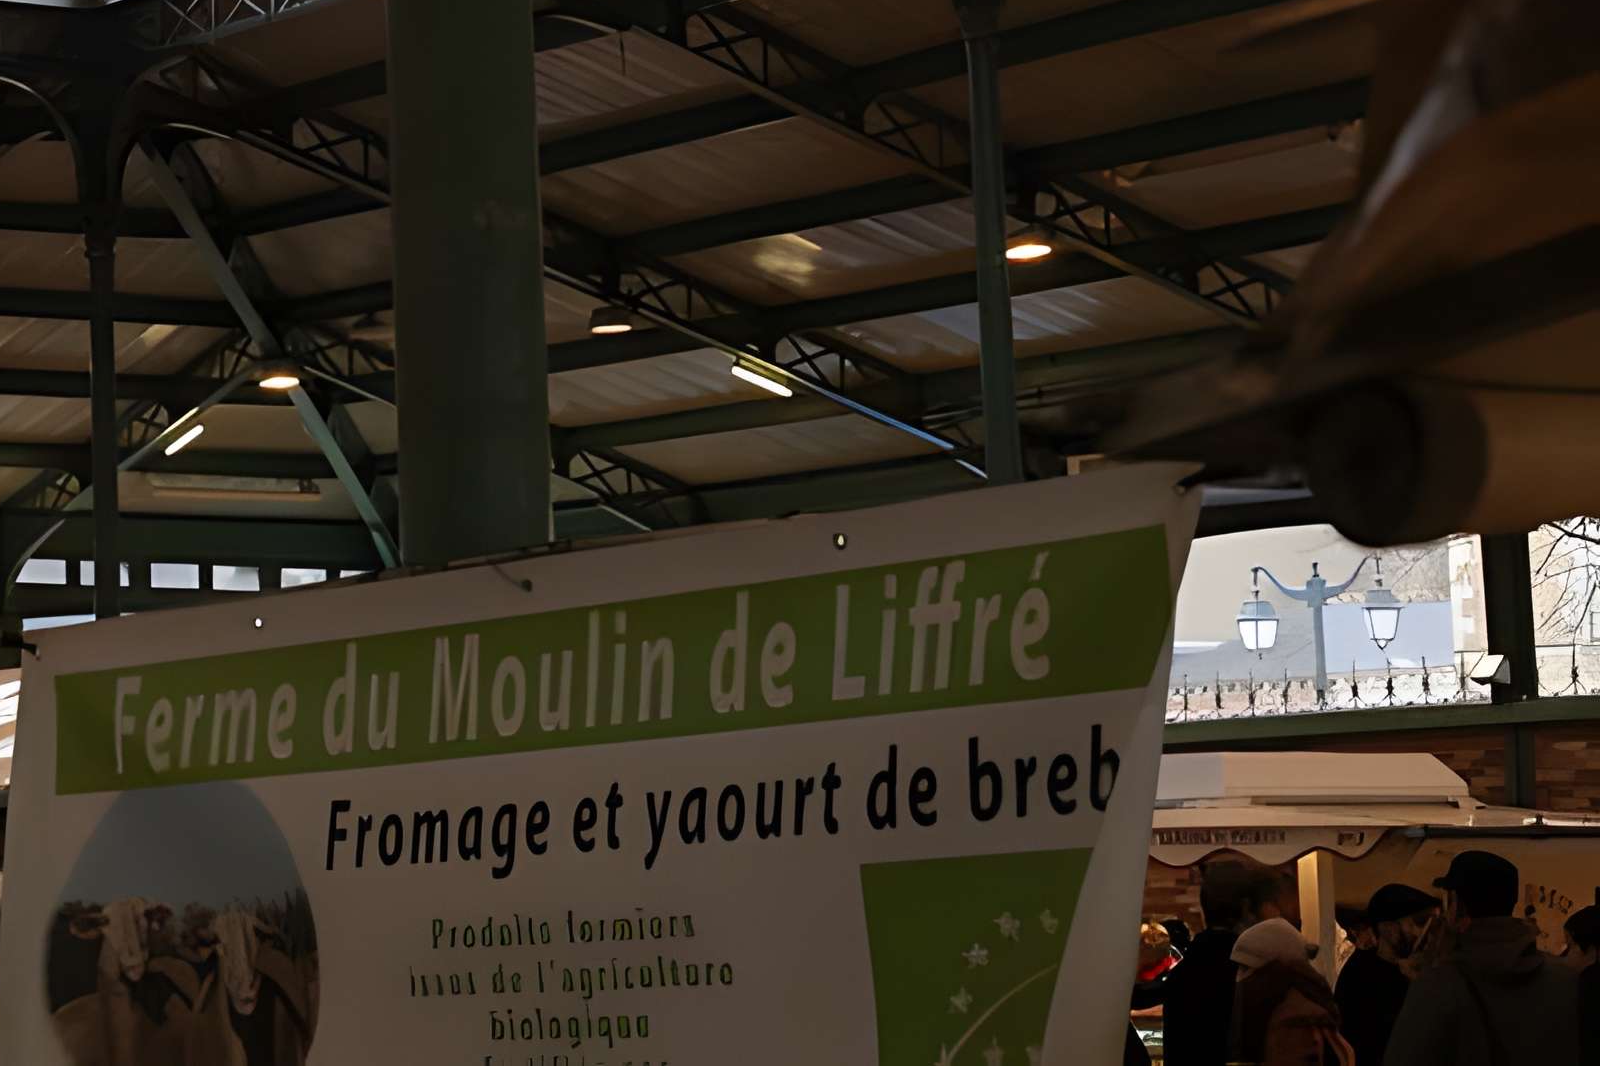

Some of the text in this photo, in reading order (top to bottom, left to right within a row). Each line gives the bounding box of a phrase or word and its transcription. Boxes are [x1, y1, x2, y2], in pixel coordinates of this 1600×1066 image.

[114, 551, 1051, 774] Ferme du Moulin de Liffré
[324, 798, 551, 880] Fromage
[572, 780, 624, 853] et
[643, 760, 842, 871] yaourt
[866, 743, 939, 831] de
